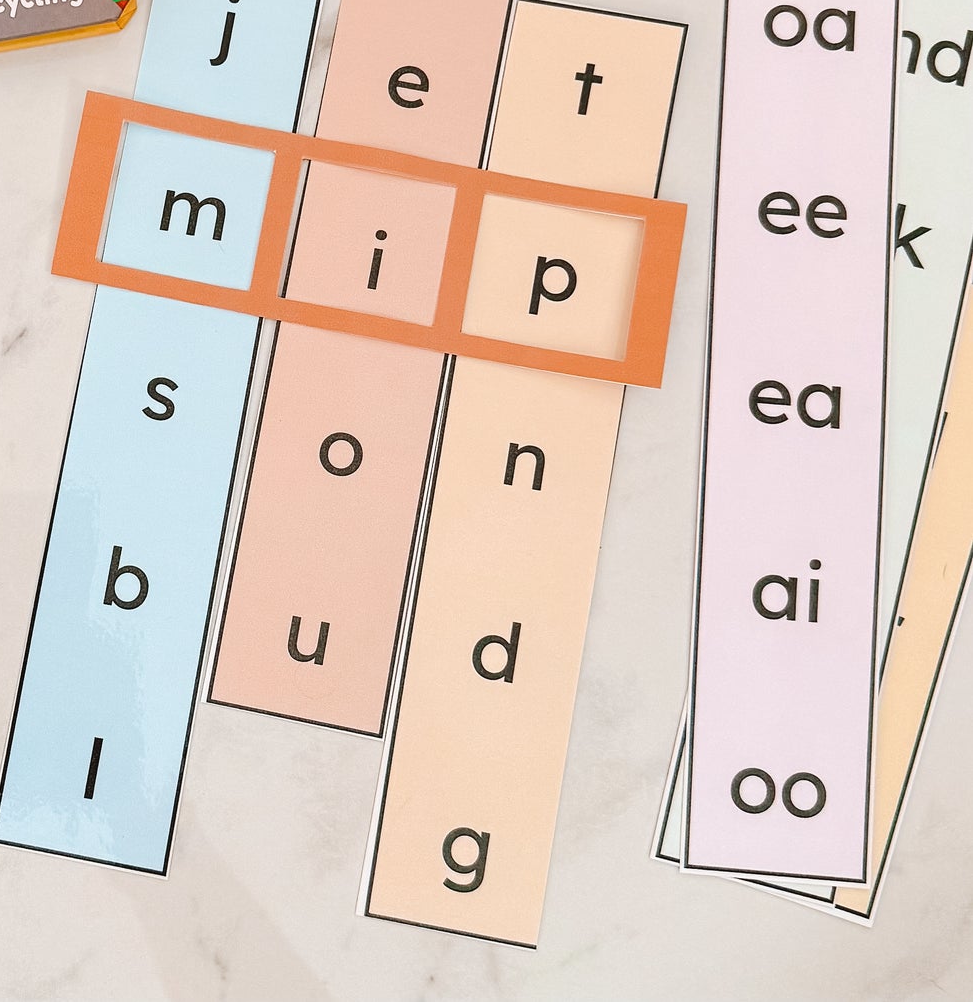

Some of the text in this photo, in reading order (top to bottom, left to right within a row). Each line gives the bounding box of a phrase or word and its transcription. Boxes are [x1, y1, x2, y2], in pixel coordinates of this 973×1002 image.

[763, 2, 857, 52] oa
[387, 65, 430, 109] e
[574, 63, 604, 116] t
[159, 189, 226, 241] m
[757, 190, 849, 239] ee
[367, 229, 388, 290] i
[528, 255, 578, 316] p
[141, 377, 179, 421] s
[748, 379, 843, 431] ea
[319, 432, 364, 477] o
[503, 442, 546, 491] n
[103, 545, 150, 611] b
[752, 559, 823, 624] ai
[287, 615, 331, 666] u
[472, 621, 522, 684] d
[83, 736, 104, 800] l
[729, 767, 828, 820] oo
[442, 827, 491, 893] g
